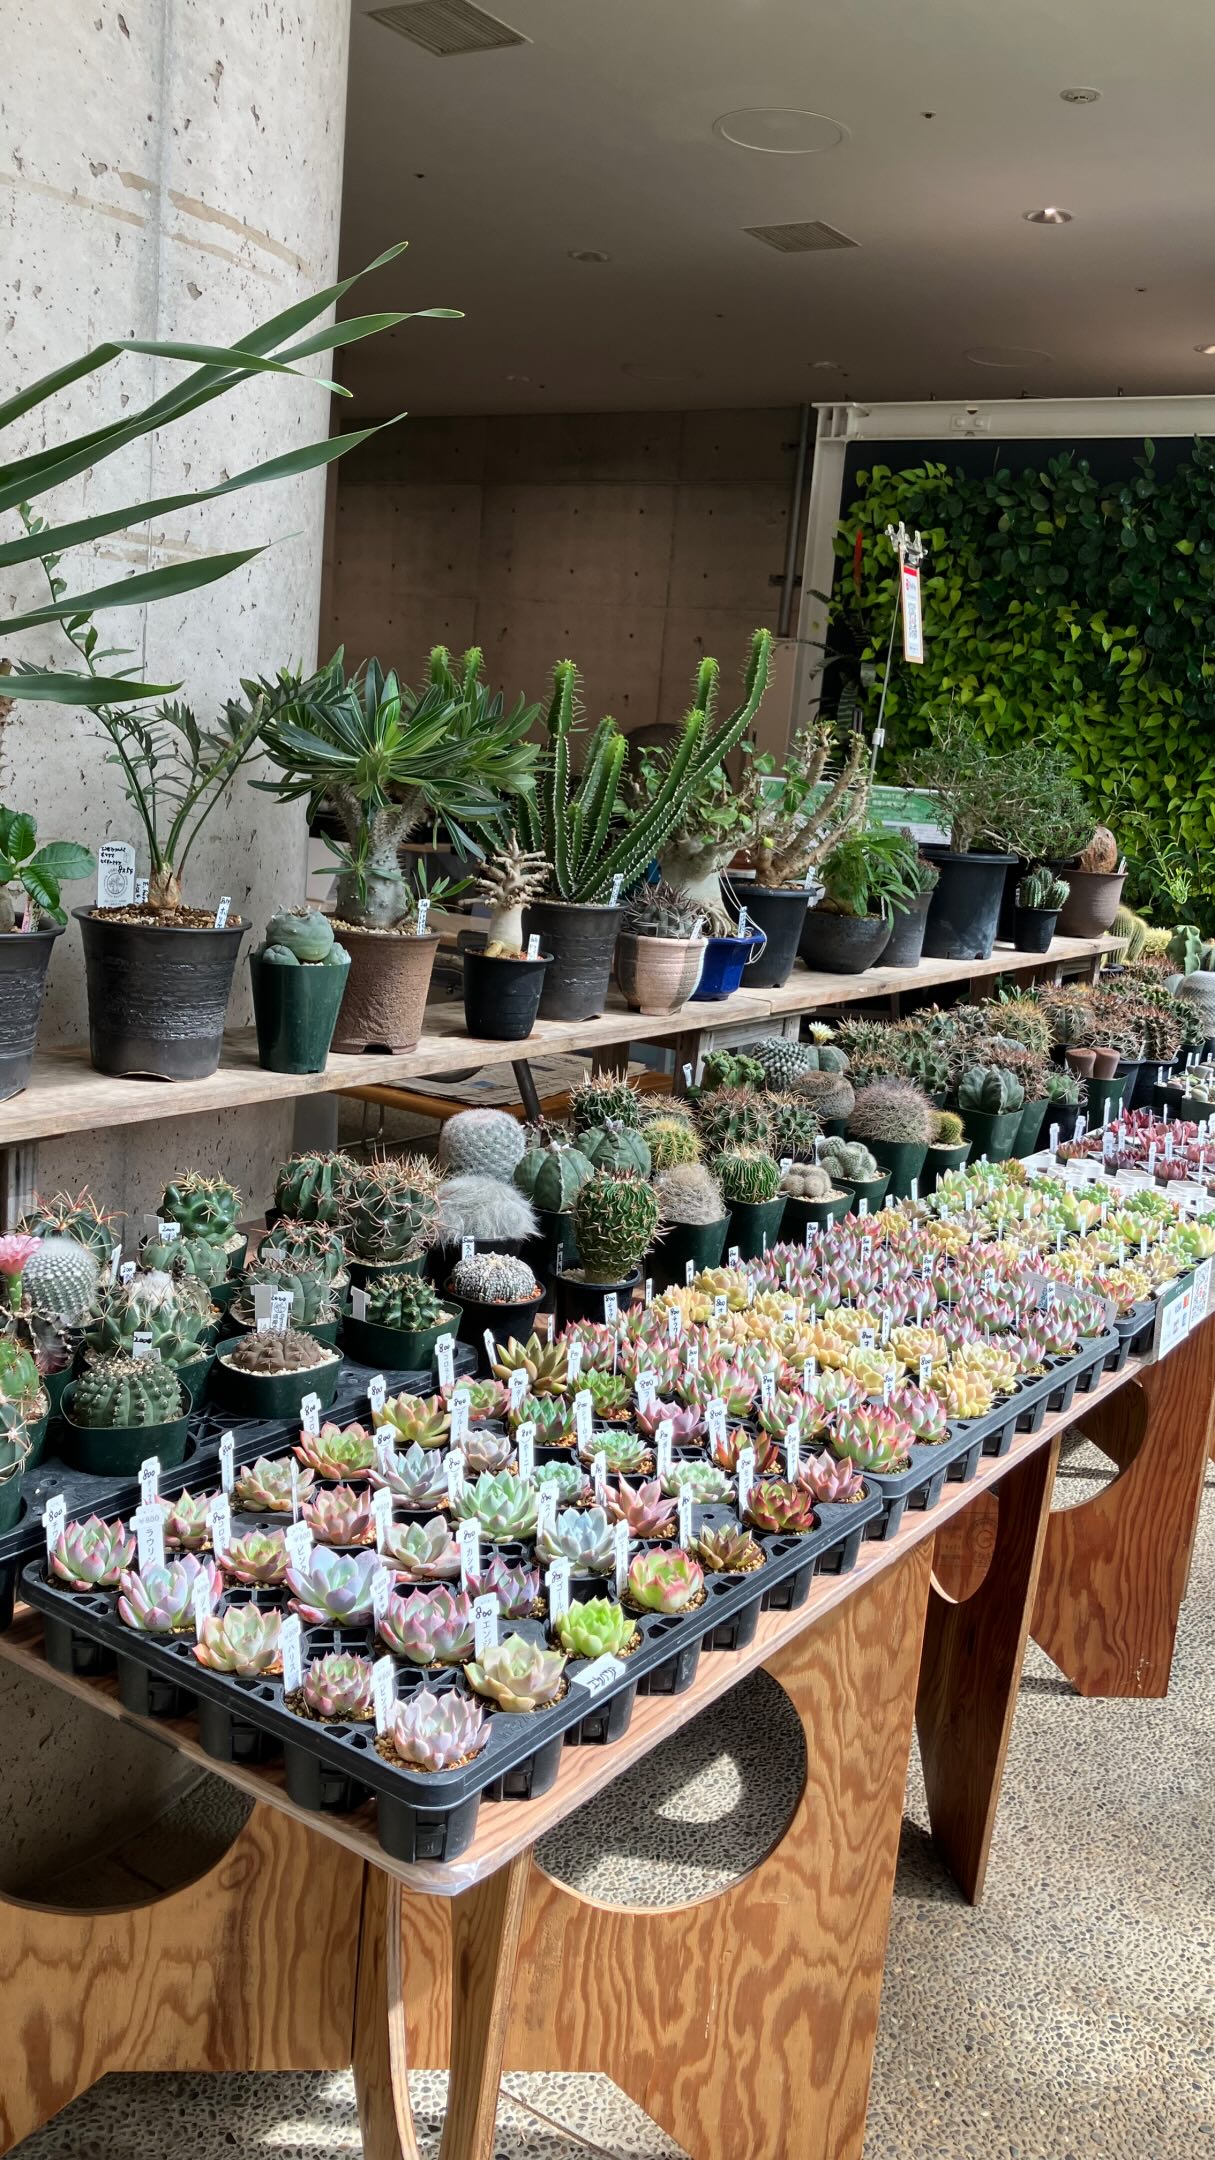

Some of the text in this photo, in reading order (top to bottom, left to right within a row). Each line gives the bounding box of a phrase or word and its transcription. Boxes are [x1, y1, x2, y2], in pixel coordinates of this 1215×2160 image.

[371, 1385, 383, 1396] 800
[304, 1404, 316, 1416] 800
[377, 1434, 391, 1445] 800
[142, 1469, 156, 1480] 800
[48, 1508, 63, 1522] 800
[212, 1511, 226, 1524] 800
[463, 1529, 476, 1540] 800
[475, 1606, 493, 1620] 800
